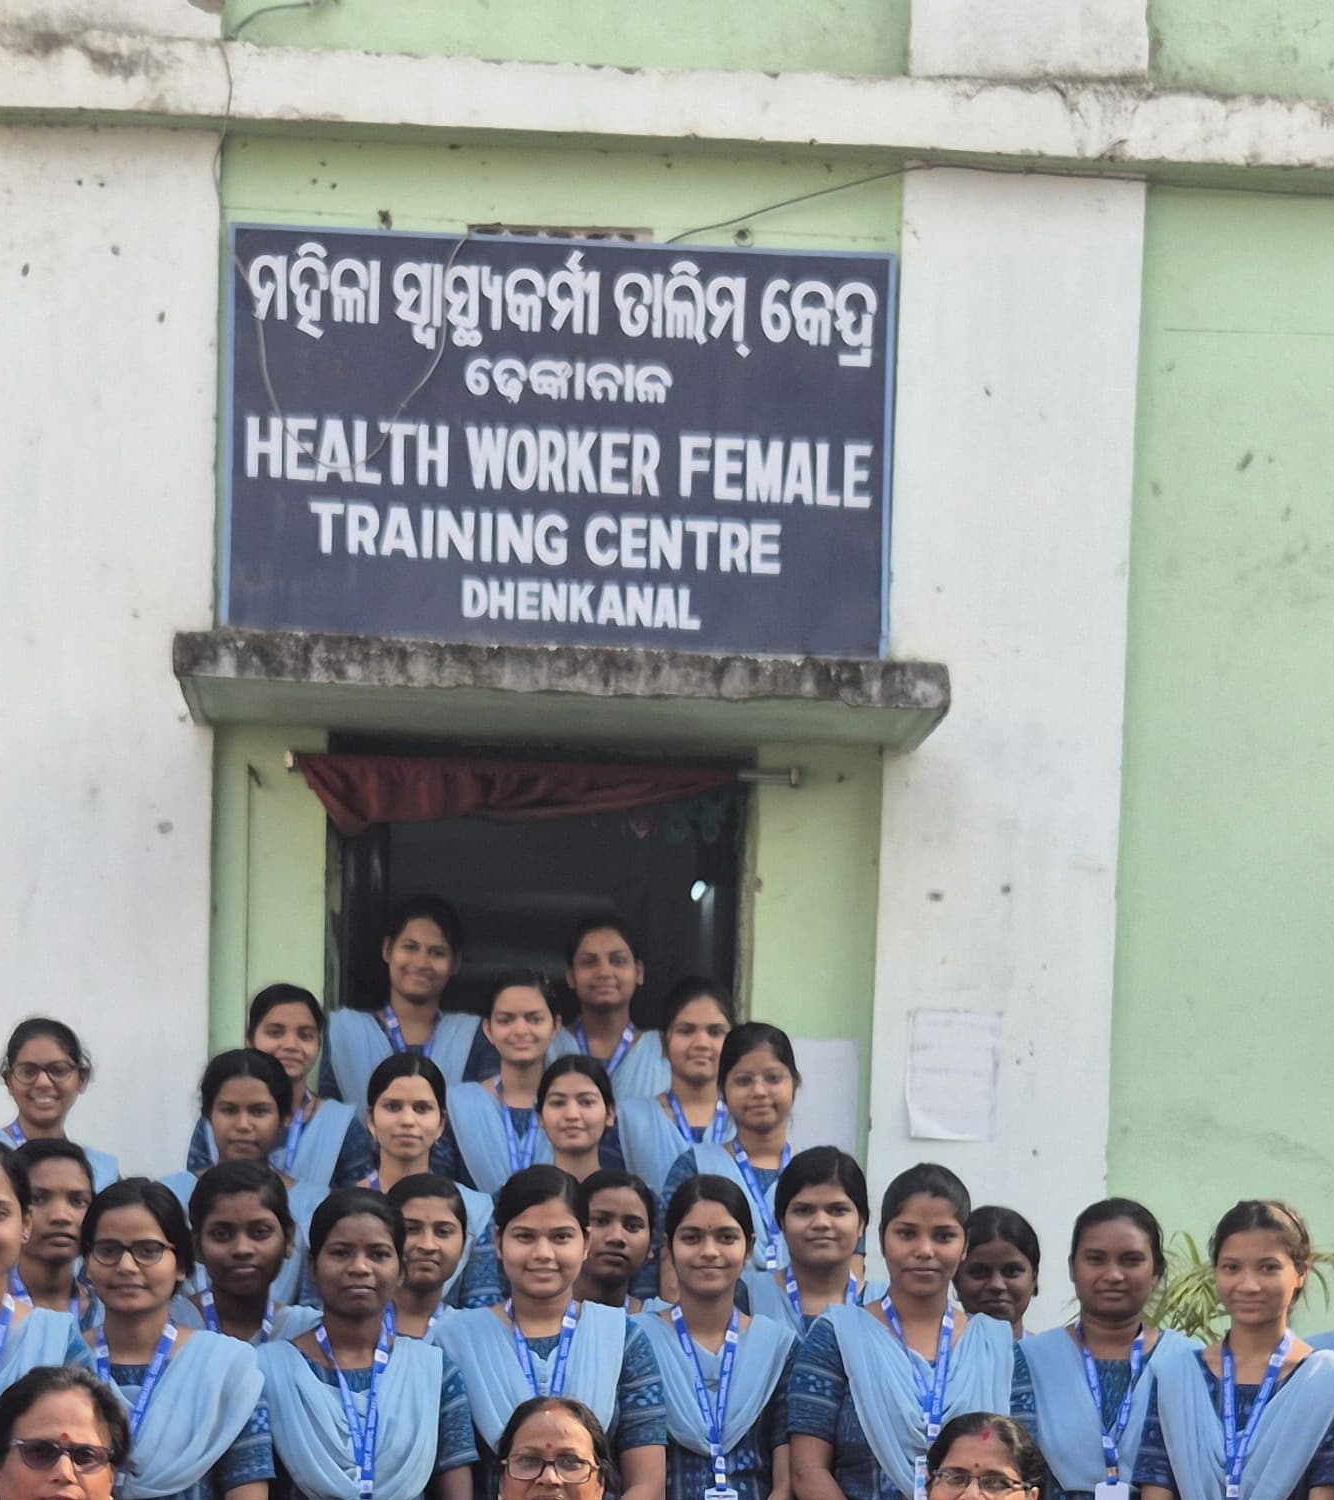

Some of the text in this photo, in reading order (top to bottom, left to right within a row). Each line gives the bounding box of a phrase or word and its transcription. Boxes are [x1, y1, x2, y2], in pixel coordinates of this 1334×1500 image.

[247, 242, 381, 339] ମହିଳା
[613, 260, 752, 357] ତାଲିମ୍
[245, 415, 873, 509] HEALTH WORKER FEMALE
[309, 500, 782, 575] TRAINING CENTRE
[461, 577, 701, 631] DHENKANAL
